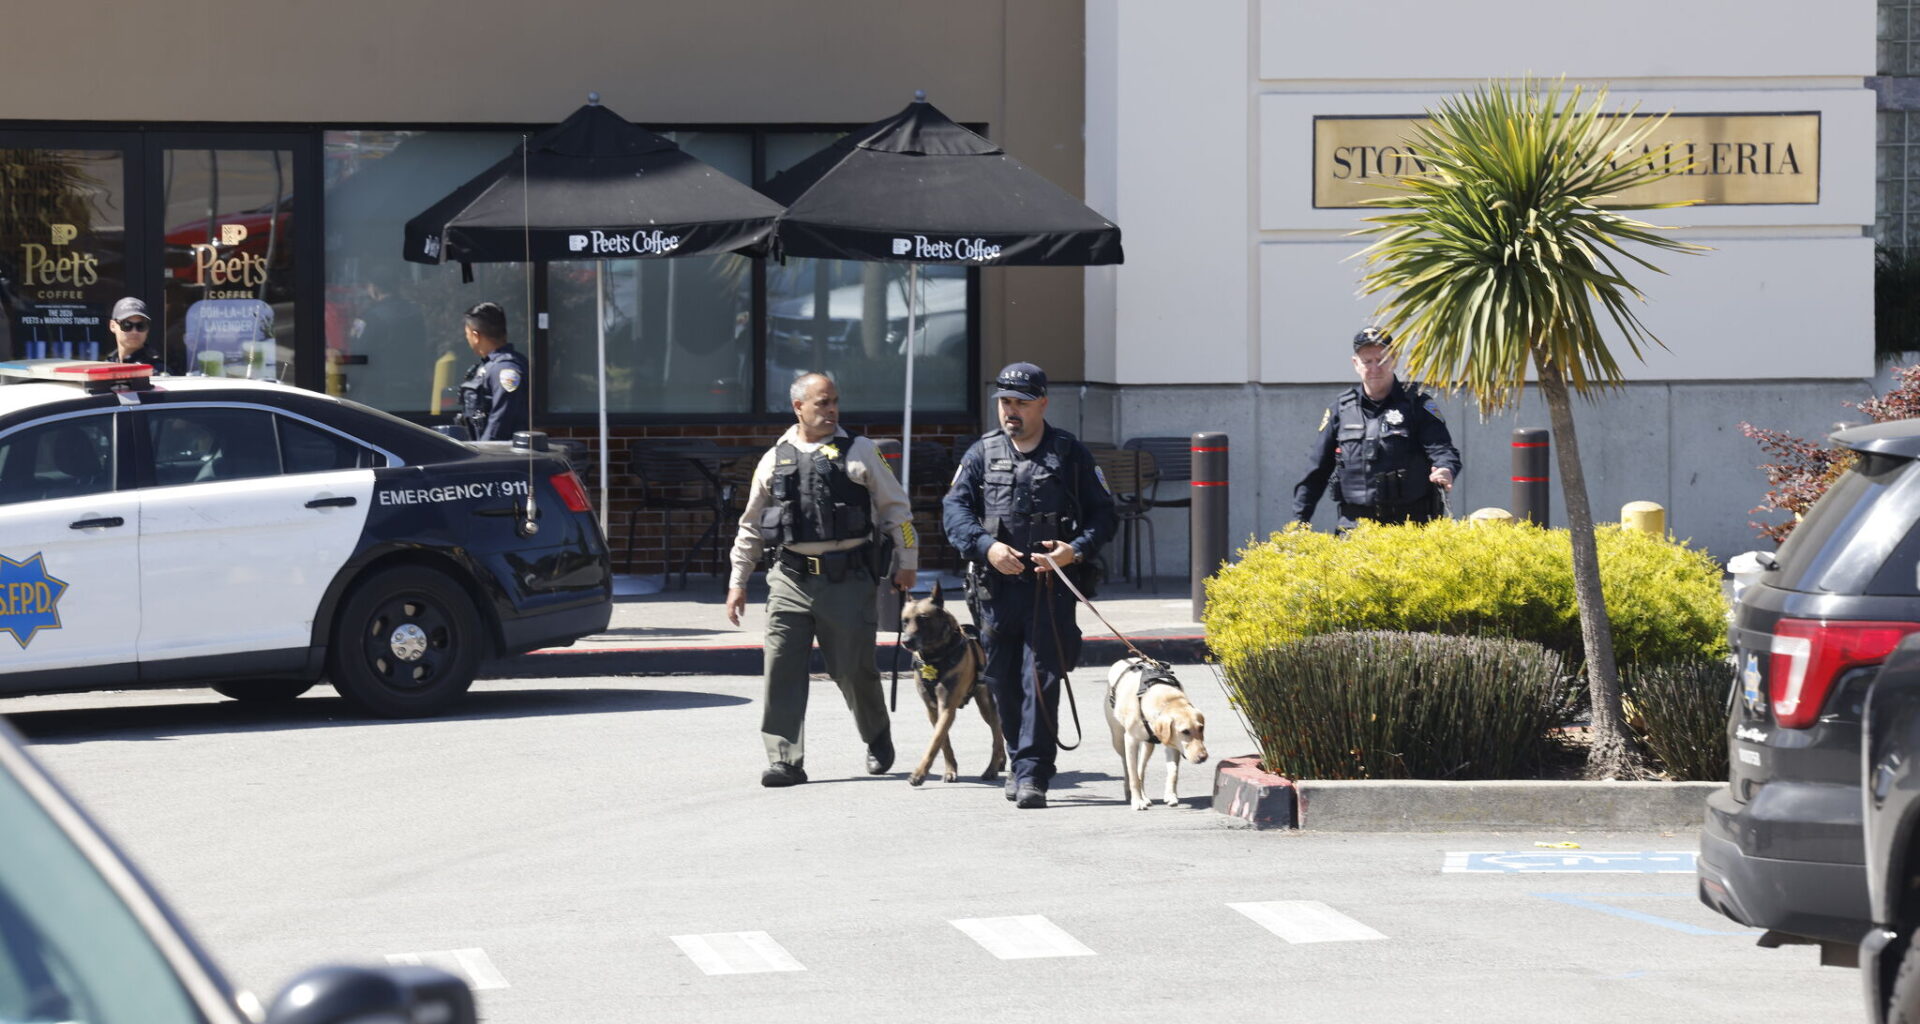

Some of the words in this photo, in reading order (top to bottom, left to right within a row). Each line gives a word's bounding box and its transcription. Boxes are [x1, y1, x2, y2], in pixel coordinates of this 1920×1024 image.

[1605, 141, 1803, 176] ALLERIA
[632, 230, 679, 254] Coffee
[954, 238, 1001, 262] Coffee
[37, 290, 84, 299] COFFEE
[208, 290, 254, 299] COFFEE
[379, 483, 493, 506] EMERGENCY
[501, 480, 528, 496] 911
